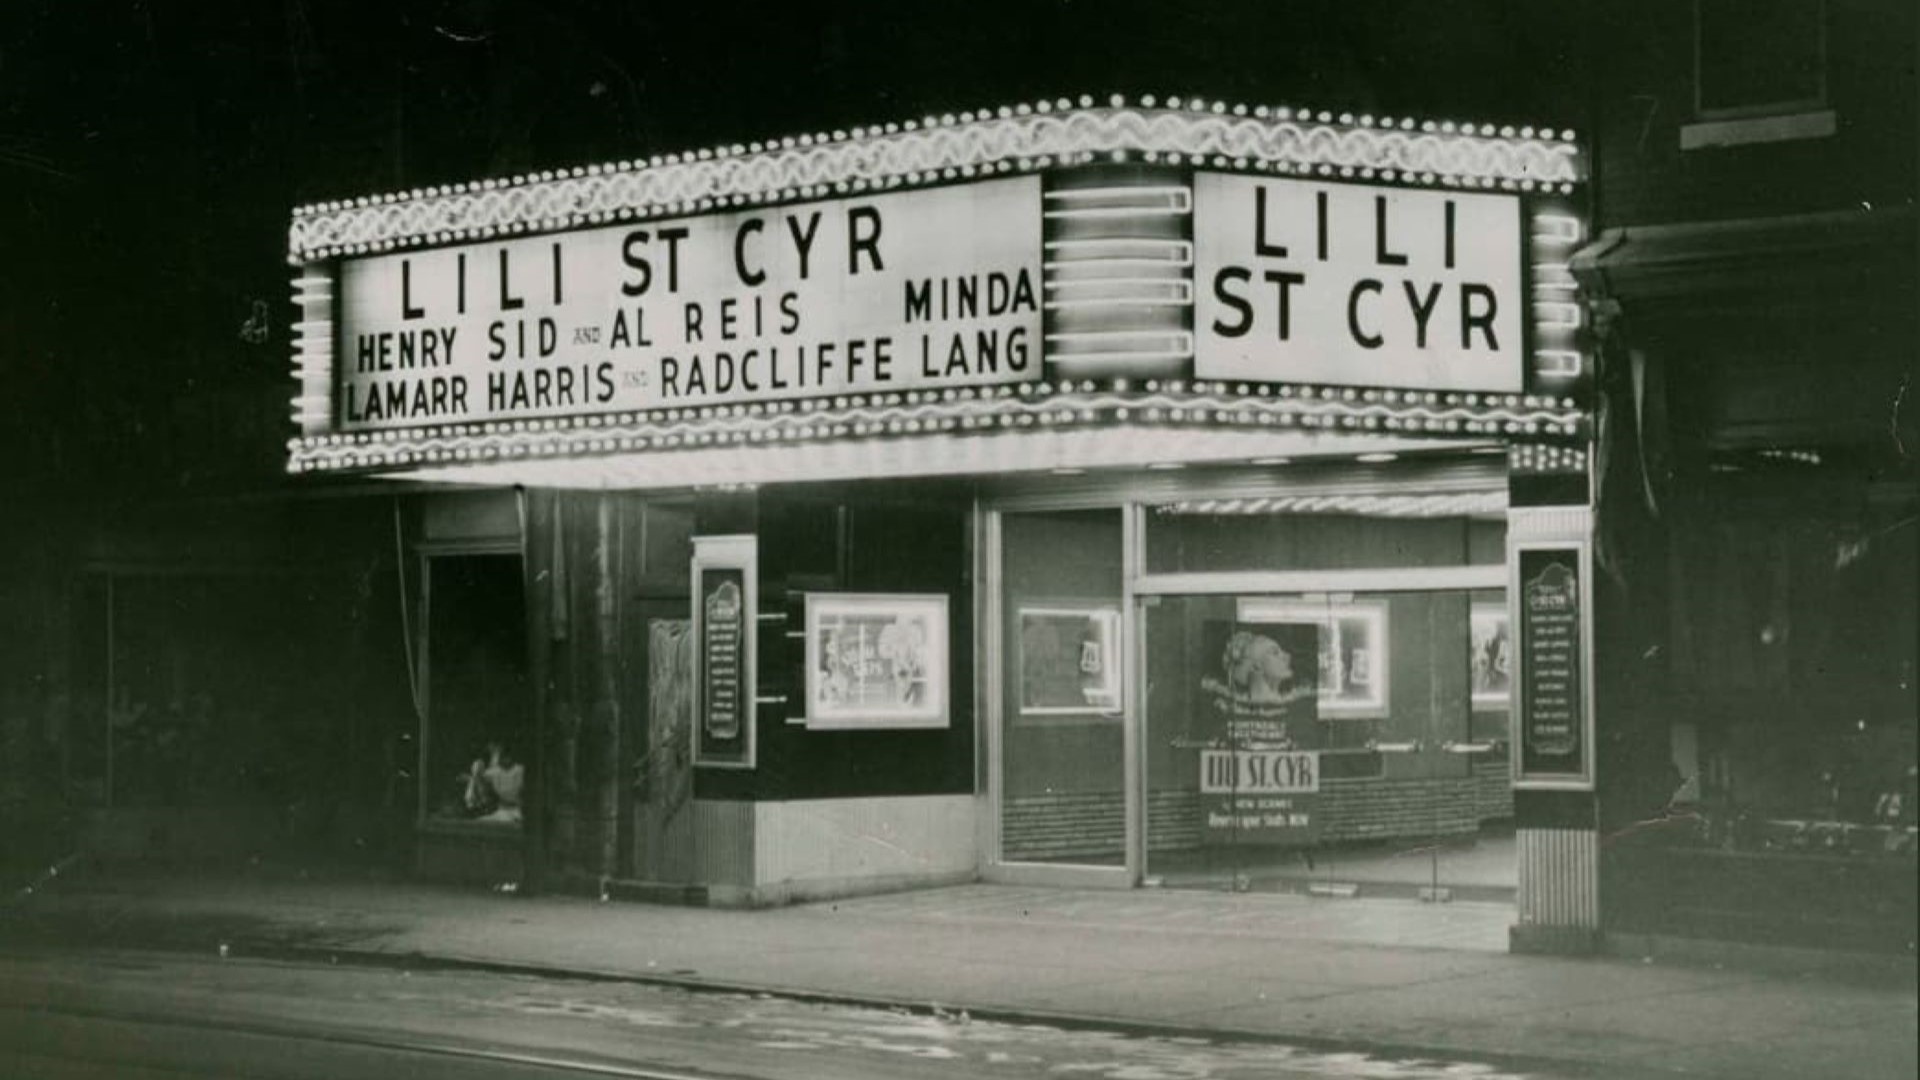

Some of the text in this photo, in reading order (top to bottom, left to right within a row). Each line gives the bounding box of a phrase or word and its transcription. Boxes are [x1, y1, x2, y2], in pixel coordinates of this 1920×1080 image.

[401, 204, 885, 321] LILI ST CYR
[1254, 185, 1457, 270] LILI
[357, 266, 1038, 373] HENRY SID AND AL REIS MINDA
[1211, 265, 1500, 352] ST CYR
[346, 375, 469, 424] LAMARR
[487, 361, 616, 413] HARRIS
[660, 336, 893, 398] RADCLIFFE
[922, 325, 1029, 379] LANG
